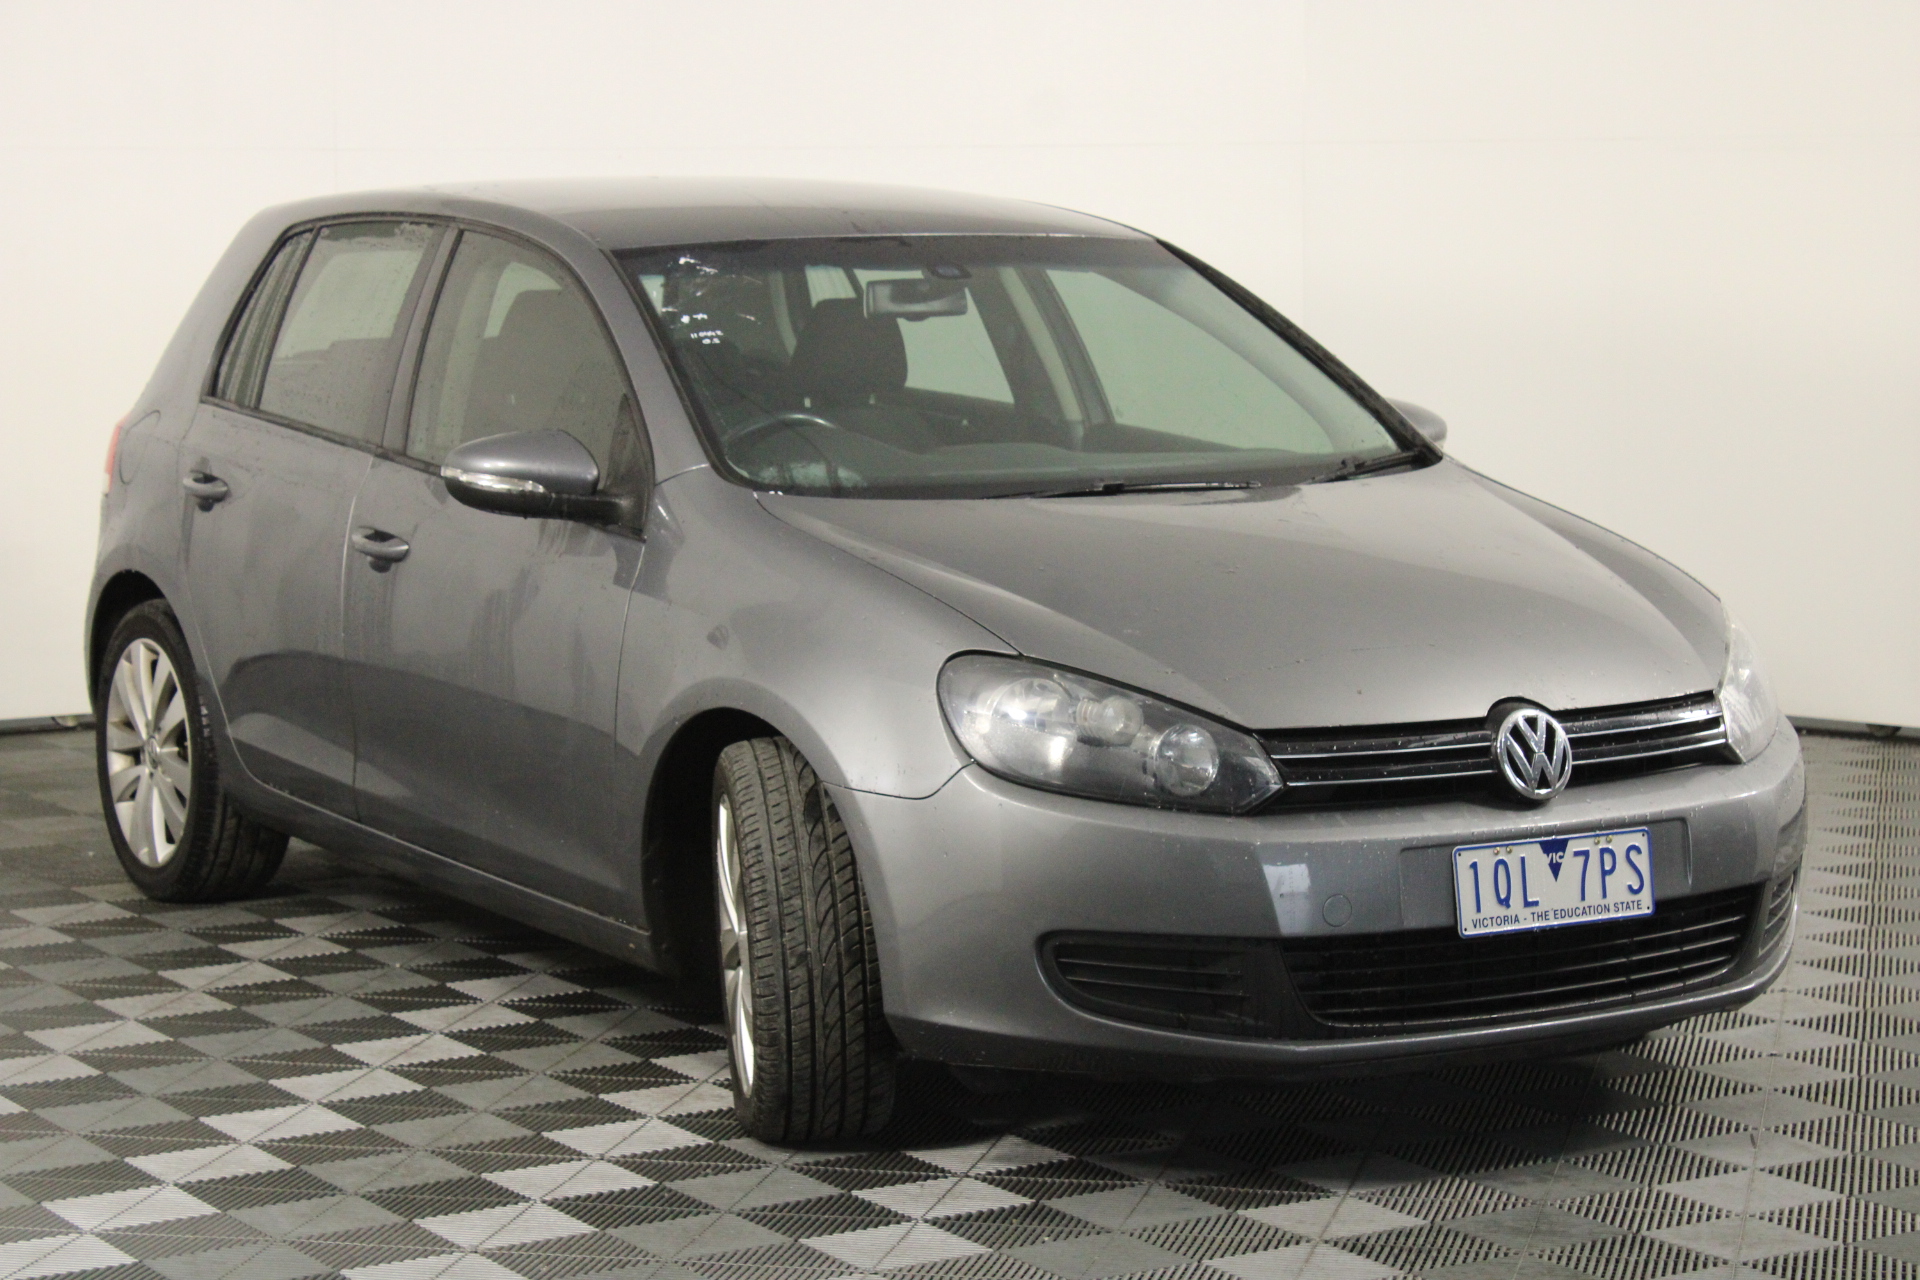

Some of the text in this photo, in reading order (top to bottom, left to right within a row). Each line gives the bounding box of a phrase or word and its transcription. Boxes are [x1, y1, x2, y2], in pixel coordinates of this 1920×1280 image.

[1497, 708, 1572, 799] VW
[1468, 843, 1645, 914] 1QL 7PS
[1548, 852, 1565, 864] VIC
[1472, 914, 1521, 929] VICTORIA
[1531, 910, 1550, 922] THE
[1553, 904, 1611, 920] EDUCATION
[1613, 899, 1643, 912] STATE
